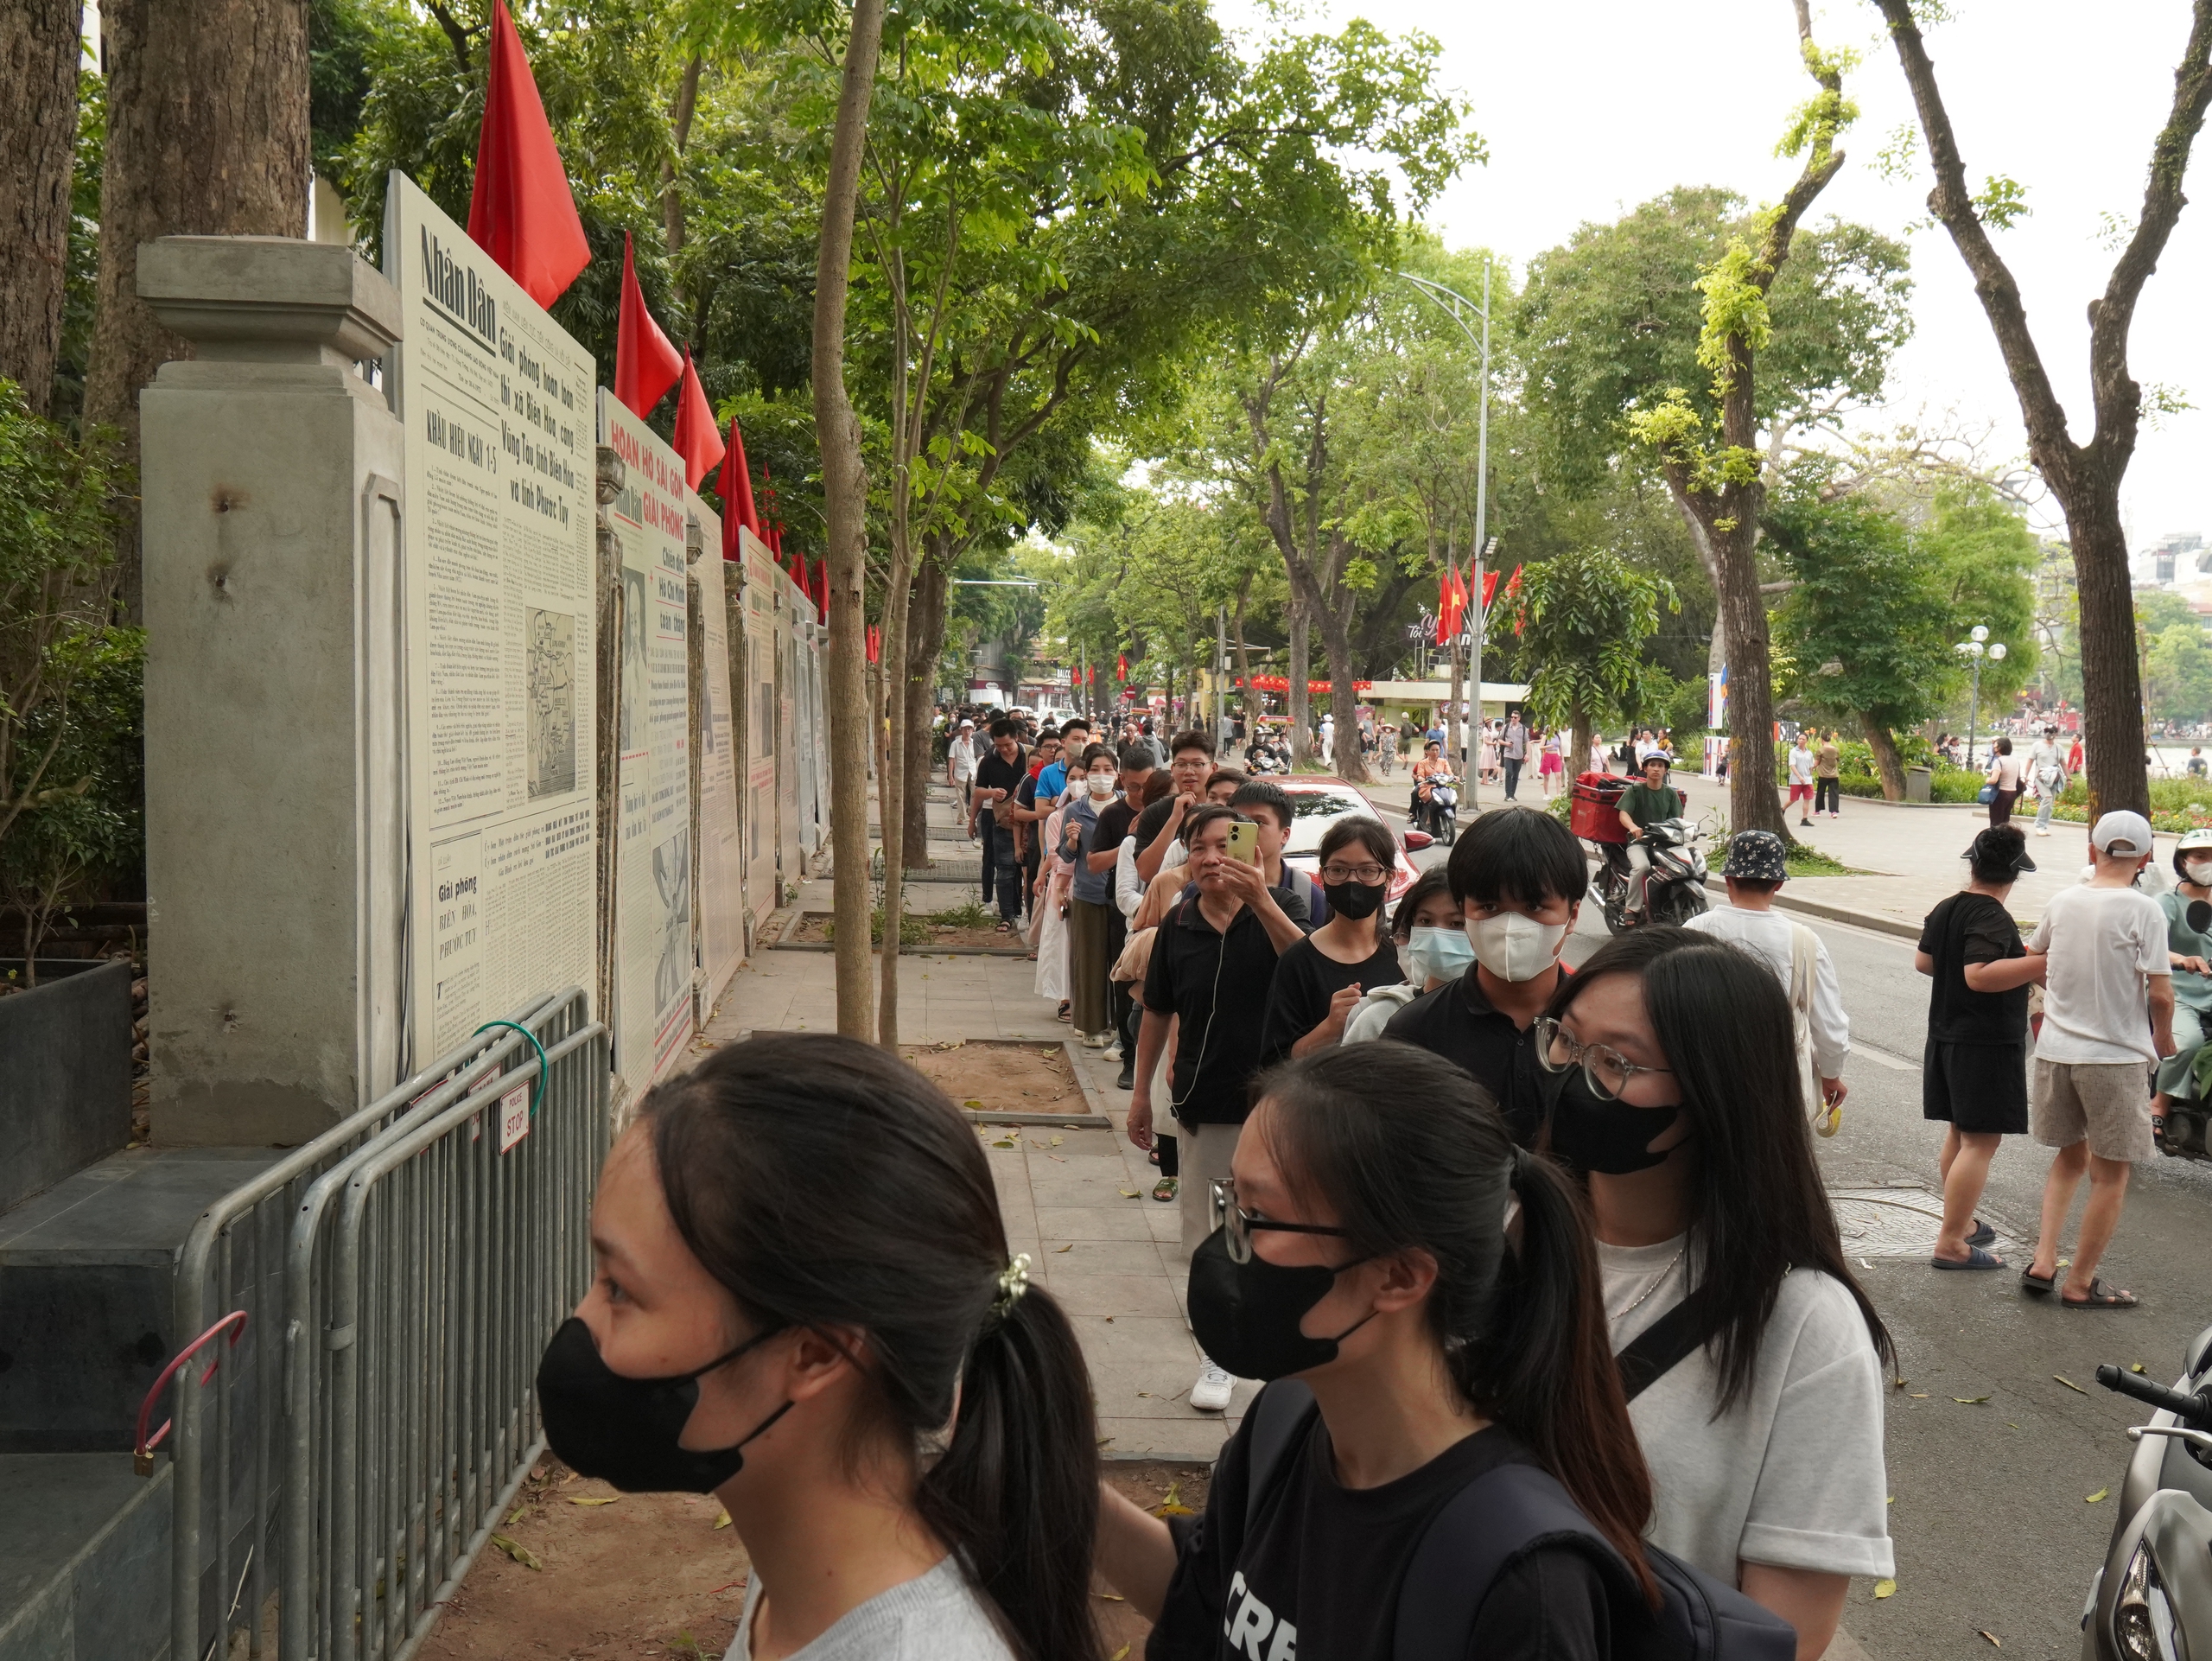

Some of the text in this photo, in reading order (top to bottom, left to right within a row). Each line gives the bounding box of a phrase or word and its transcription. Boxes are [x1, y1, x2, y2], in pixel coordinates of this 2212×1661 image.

[421, 223, 496, 345] Nhân Dân
[500, 326, 514, 366] Giải
[519, 345, 539, 389] phóng
[543, 362, 557, 400] hoàn
[562, 379, 574, 411] toàn
[501, 374, 510, 411] thị
[514, 390, 523, 416] xã
[527, 391, 541, 428] Biên
[561, 421, 574, 455] cảng
[449, 423, 465, 461] HIỆU
[467, 432, 483, 468] NGÀY
[486, 443, 497, 474] 1-5
[501, 419, 520, 465] Vũng
[550, 450, 562, 483] Biên
[612, 419, 639, 471] HOAN
[642, 446, 653, 481] HÔ
[657, 455, 667, 492] SÀI
[670, 468, 683, 503] GÒN
[511, 477, 518, 502] và
[537, 484, 556, 519] Phước
[558, 495, 569, 531] Tuy
[644, 488, 658, 529] GIẢI
[661, 505, 683, 543] PHÓNG
[1408, 625, 1424, 639] Tôi
[438, 878, 453, 902] Giải
[439, 910, 455, 932] BIÊN
[439, 927, 477, 960] PHƯỚC TUY
[507, 1111, 524, 1137] STOP
[509, 1092, 522, 1108] POLICE
